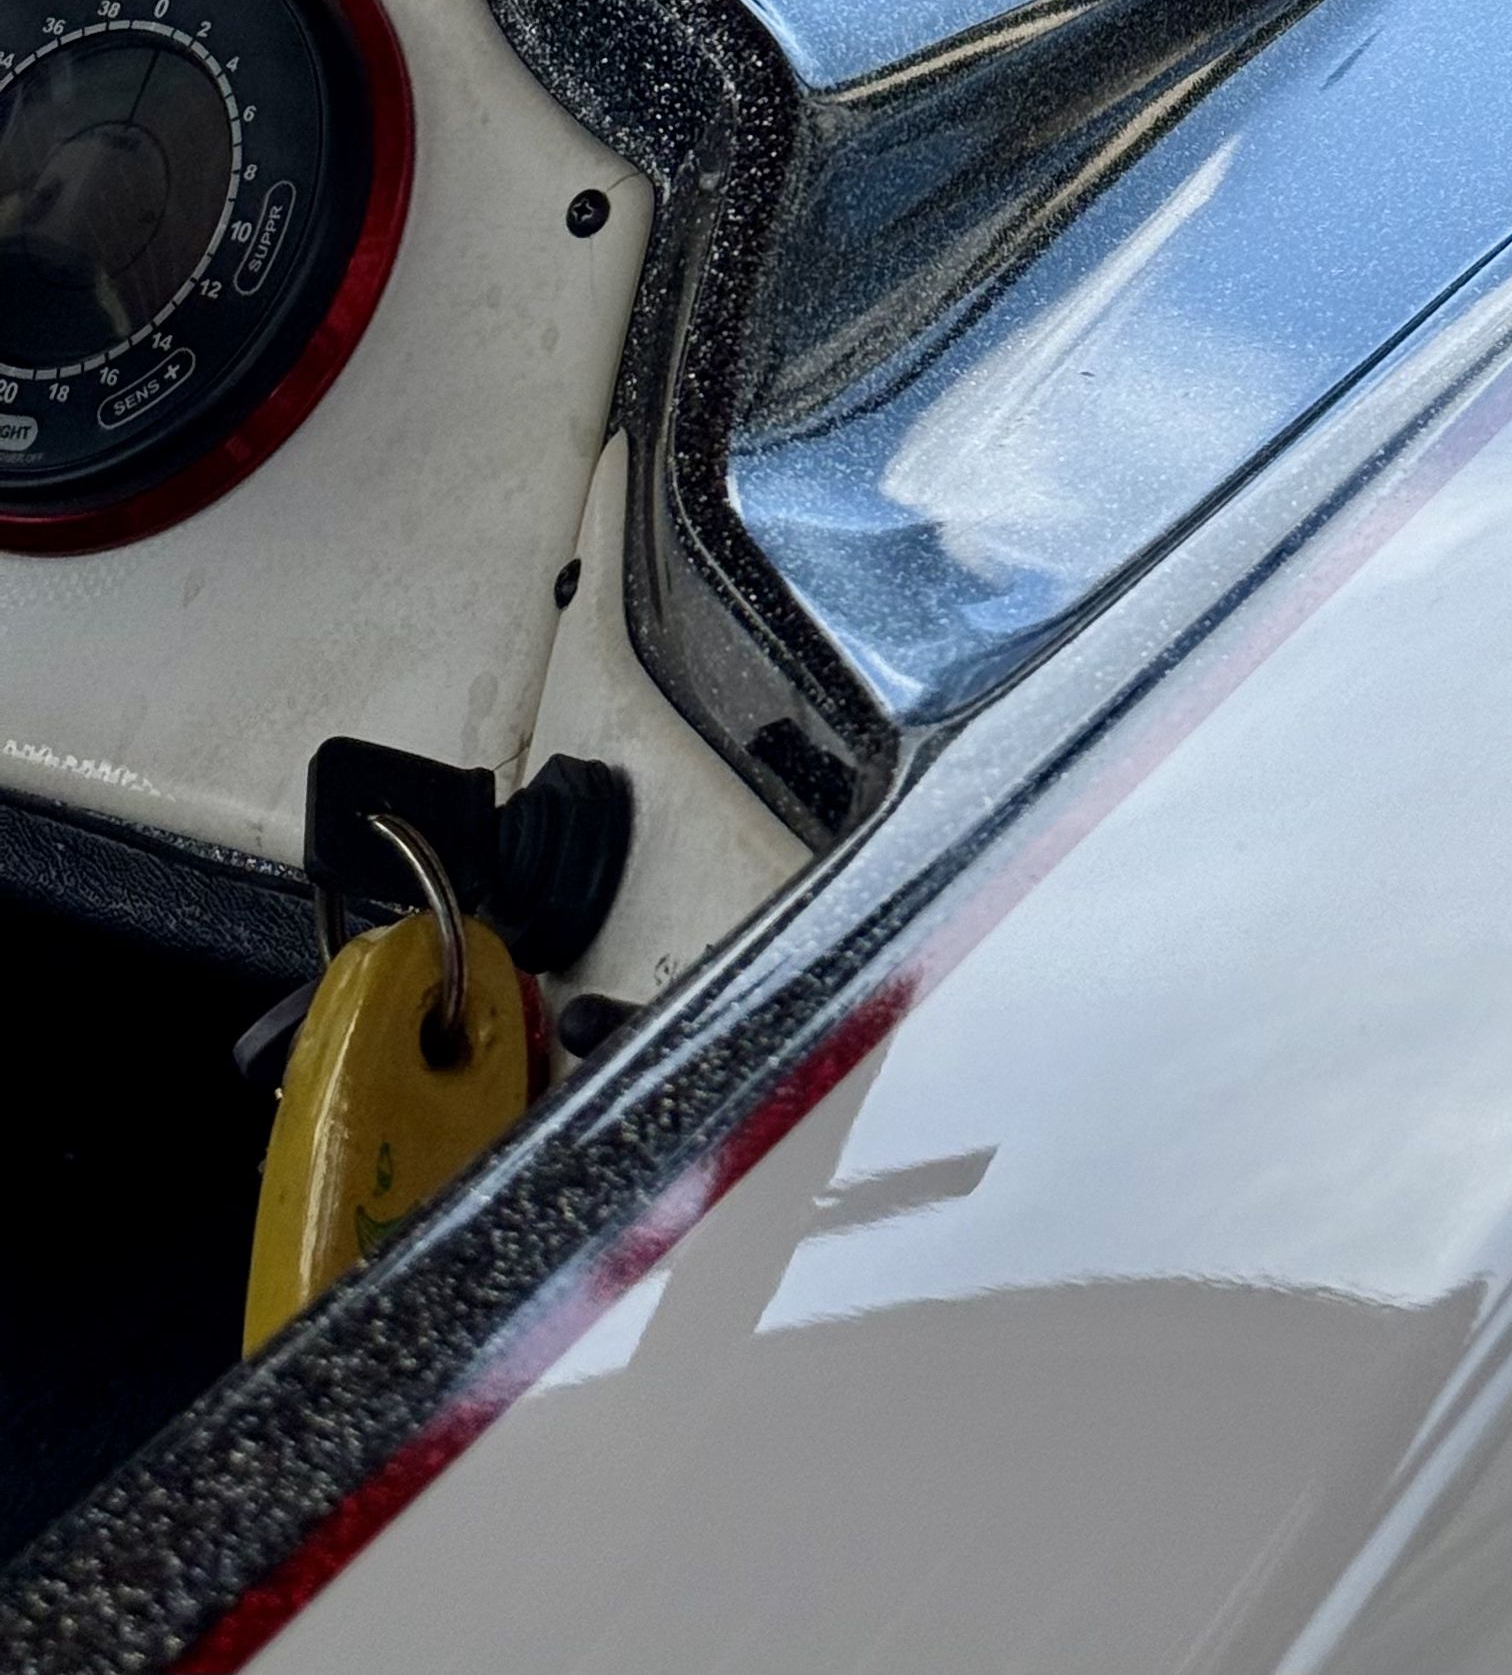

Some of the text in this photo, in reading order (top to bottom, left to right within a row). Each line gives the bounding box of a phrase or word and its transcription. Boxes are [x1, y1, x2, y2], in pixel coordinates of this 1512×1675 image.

[97, 0, 121, 18] 38
[42, 17, 67, 35] 36
[196, 21, 212, 38] 2
[225, 56, 240, 72] 4
[243, 105, 257, 122] 6
[244, 164, 258, 181] 8
[231, 220, 253, 243] 10
[247, 205, 284, 272] SUPPR
[200, 279, 222, 299] 12
[152, 332, 173, 351] 14
[99, 366, 120, 386] 16
[48, 382, 70, 403] 18
[113, 379, 160, 416] SENS
[0, 424, 32, 440] GHT
